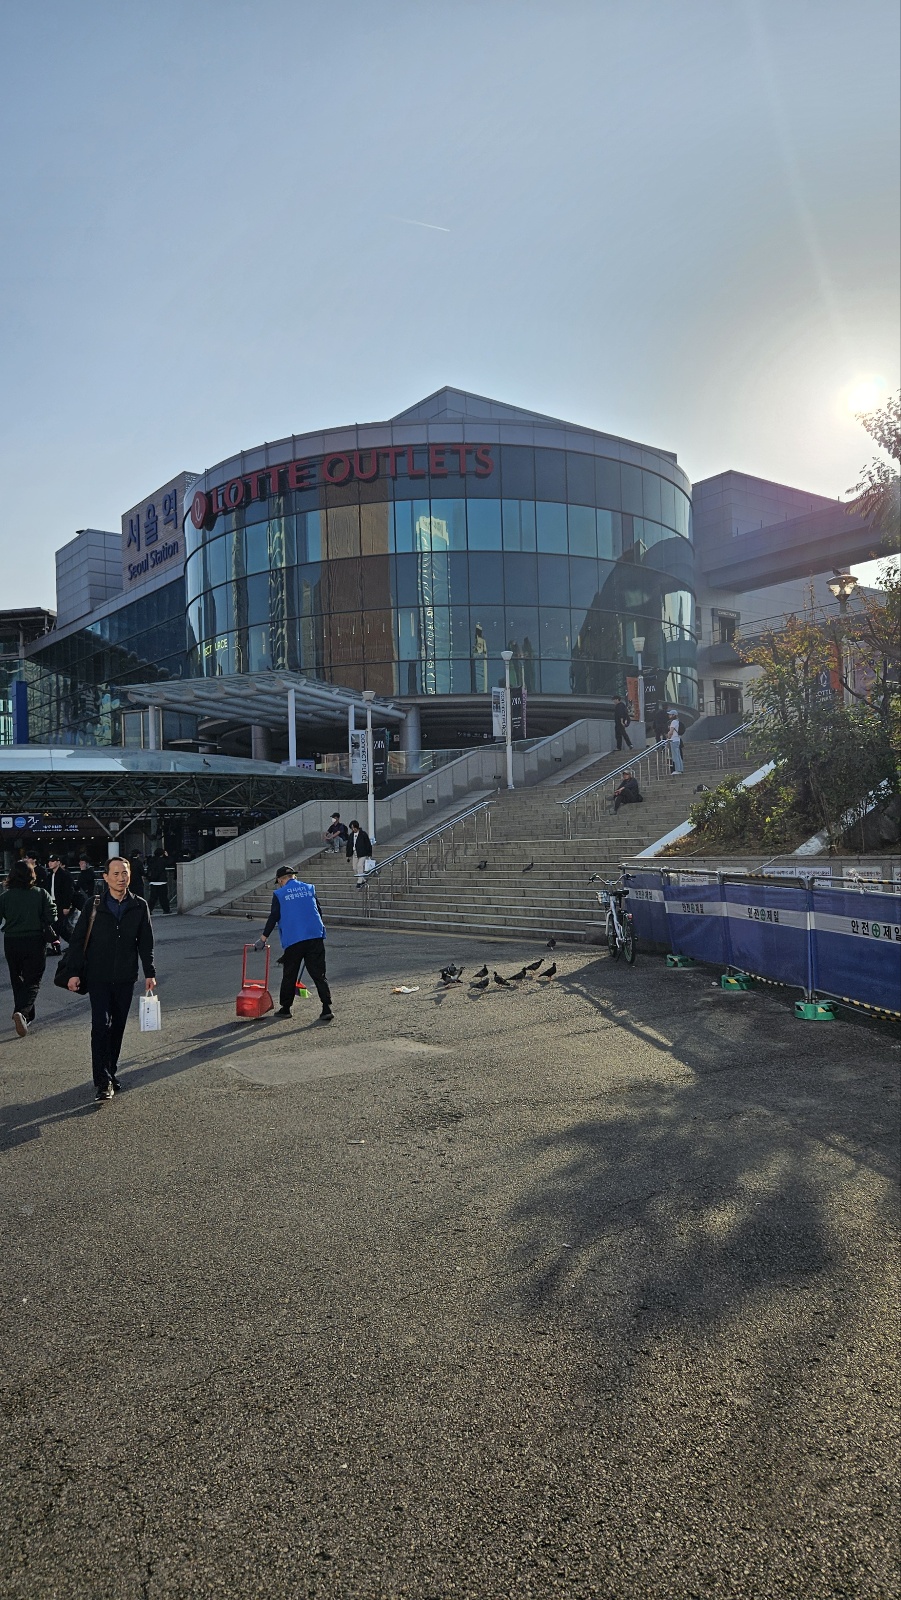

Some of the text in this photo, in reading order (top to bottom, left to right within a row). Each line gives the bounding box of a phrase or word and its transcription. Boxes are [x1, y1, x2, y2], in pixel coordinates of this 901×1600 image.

[211, 444, 494, 514] LOTTE OUTLETS
[127, 489, 178, 551] 서울역
[128, 540, 179, 581] Seoul Station
[851, 920, 901, 941] 안전 제일
